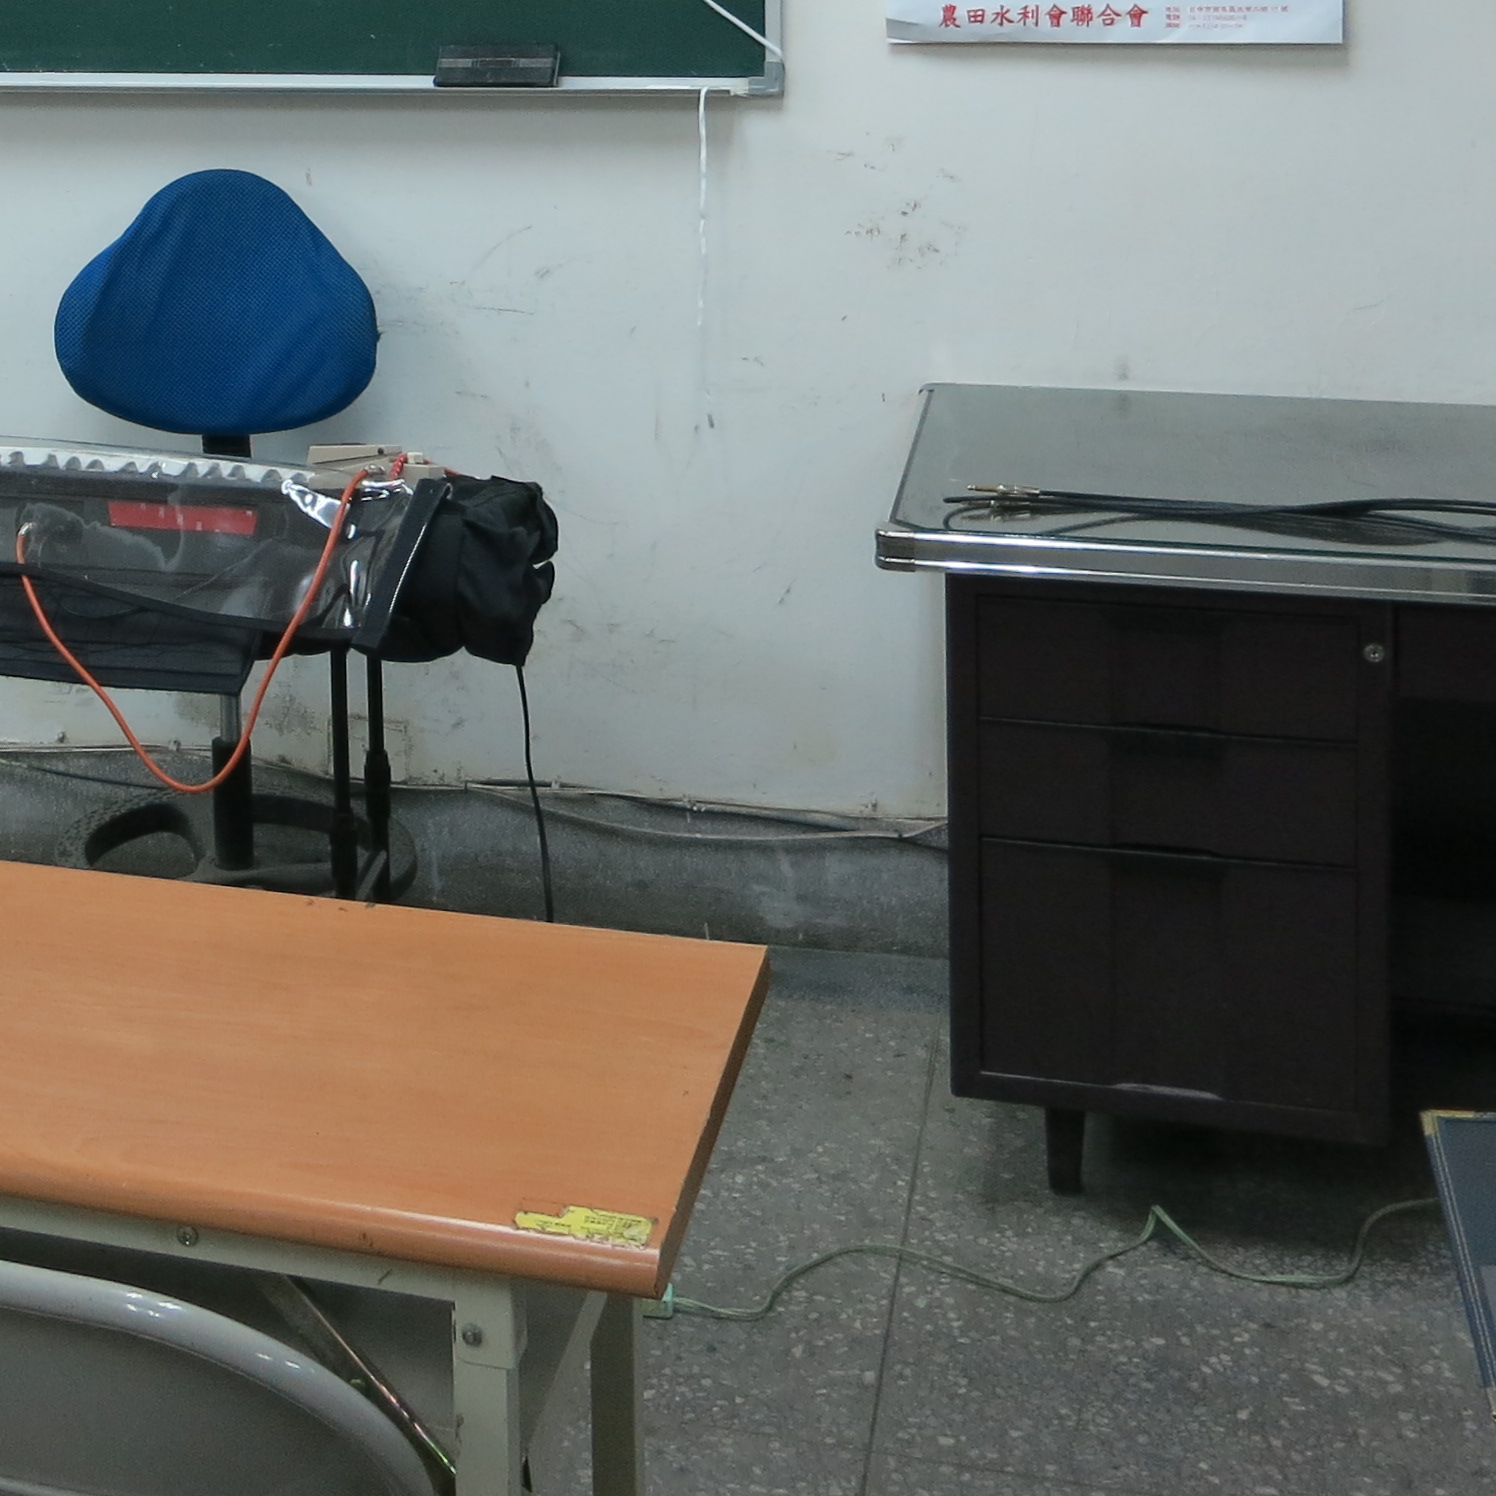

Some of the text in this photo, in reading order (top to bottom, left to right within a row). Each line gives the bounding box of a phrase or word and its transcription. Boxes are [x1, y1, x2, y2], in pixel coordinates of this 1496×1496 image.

[938, 4, 1150, 29] 農田水利會聯合會
